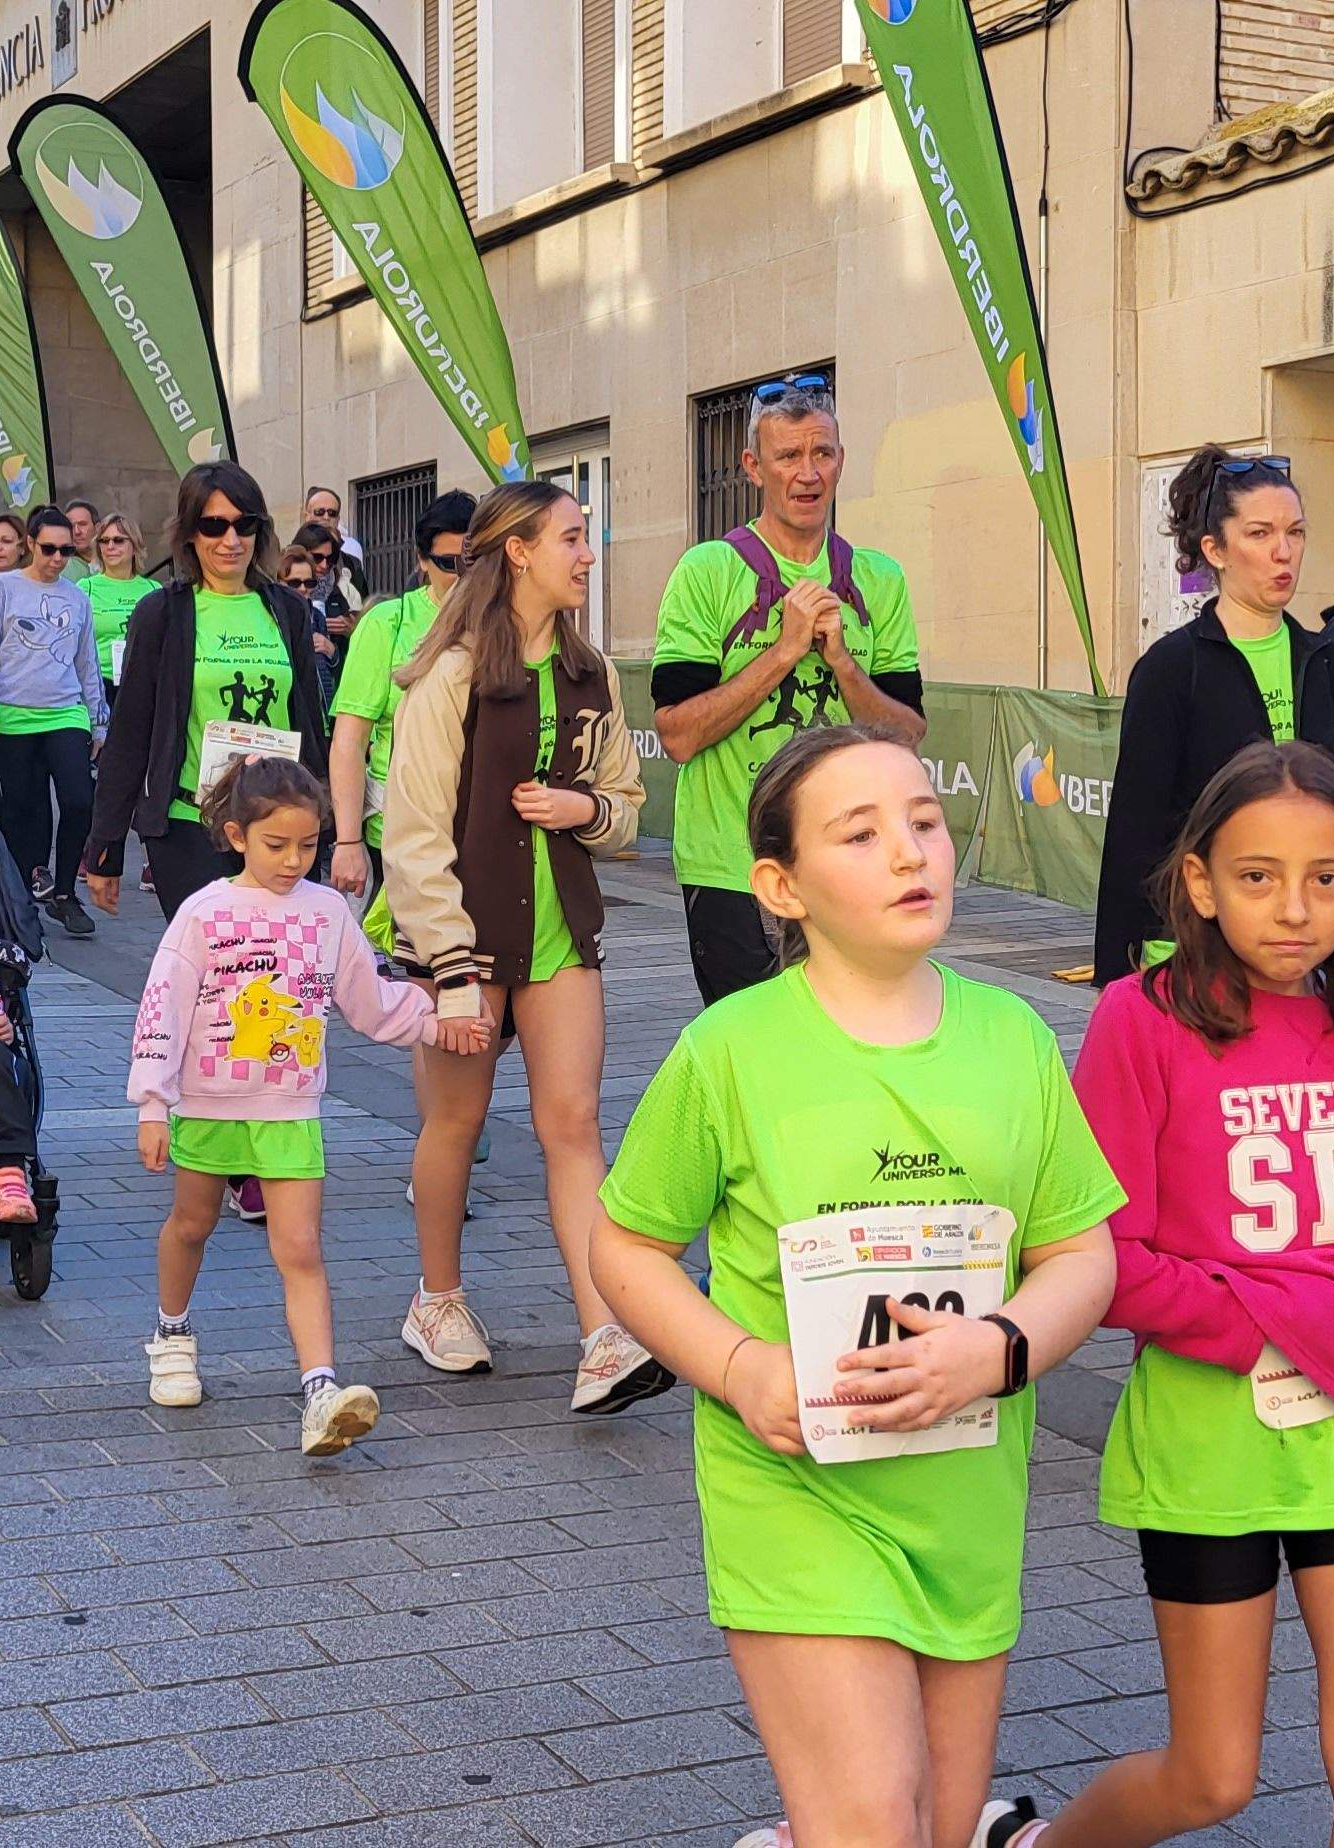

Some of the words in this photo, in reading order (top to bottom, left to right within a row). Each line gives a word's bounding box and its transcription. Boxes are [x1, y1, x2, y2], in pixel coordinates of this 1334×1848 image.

[733, 641, 746, 650] EN
[213, 956, 278, 976] PIKACHU
[892, 1152, 940, 1171] TOUR
[882, 1168, 946, 1182] UNIVERSO
[817, 1202, 837, 1215] EN
